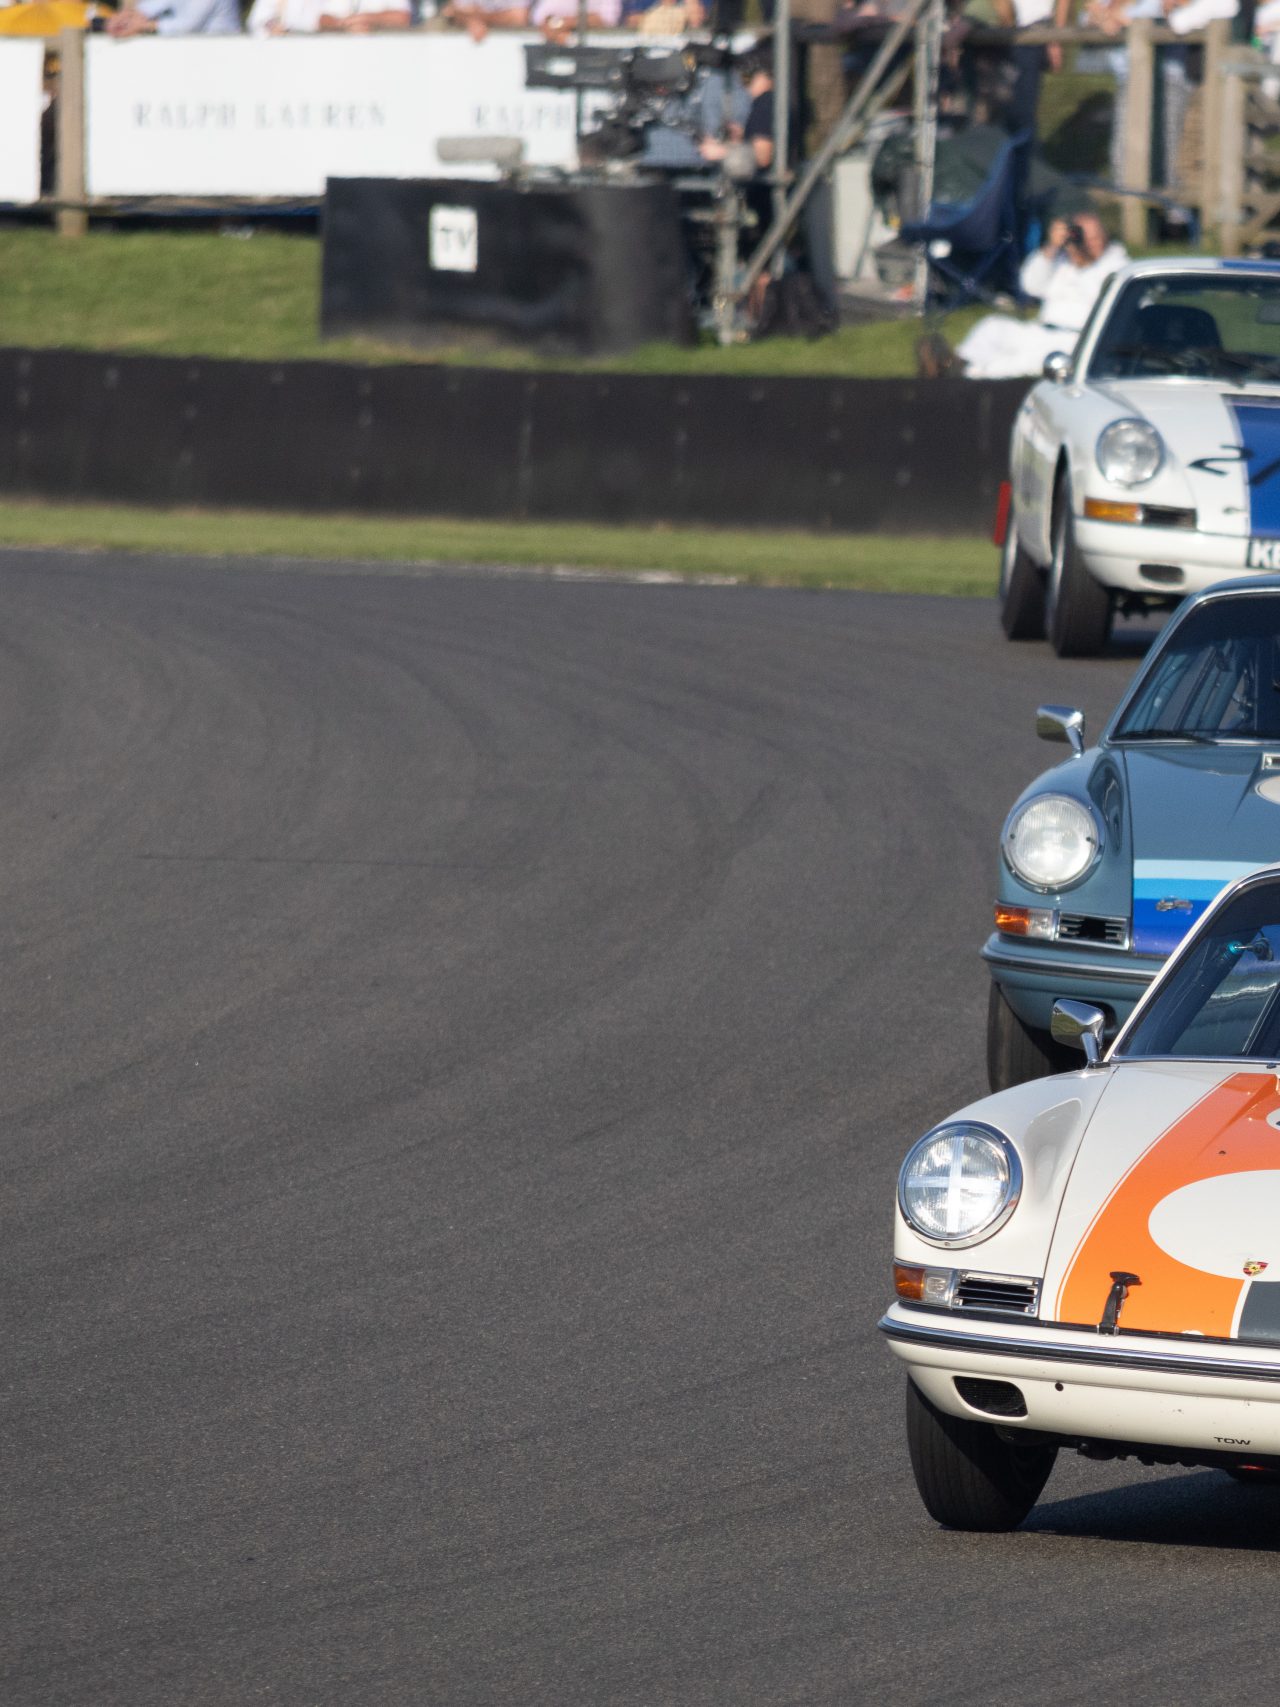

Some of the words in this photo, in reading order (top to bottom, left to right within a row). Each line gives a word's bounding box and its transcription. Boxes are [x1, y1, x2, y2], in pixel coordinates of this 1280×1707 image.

[133, 101, 237, 128] RALPH
[439, 225, 474, 252] TV
[1213, 1436, 1251, 1446] TOW
